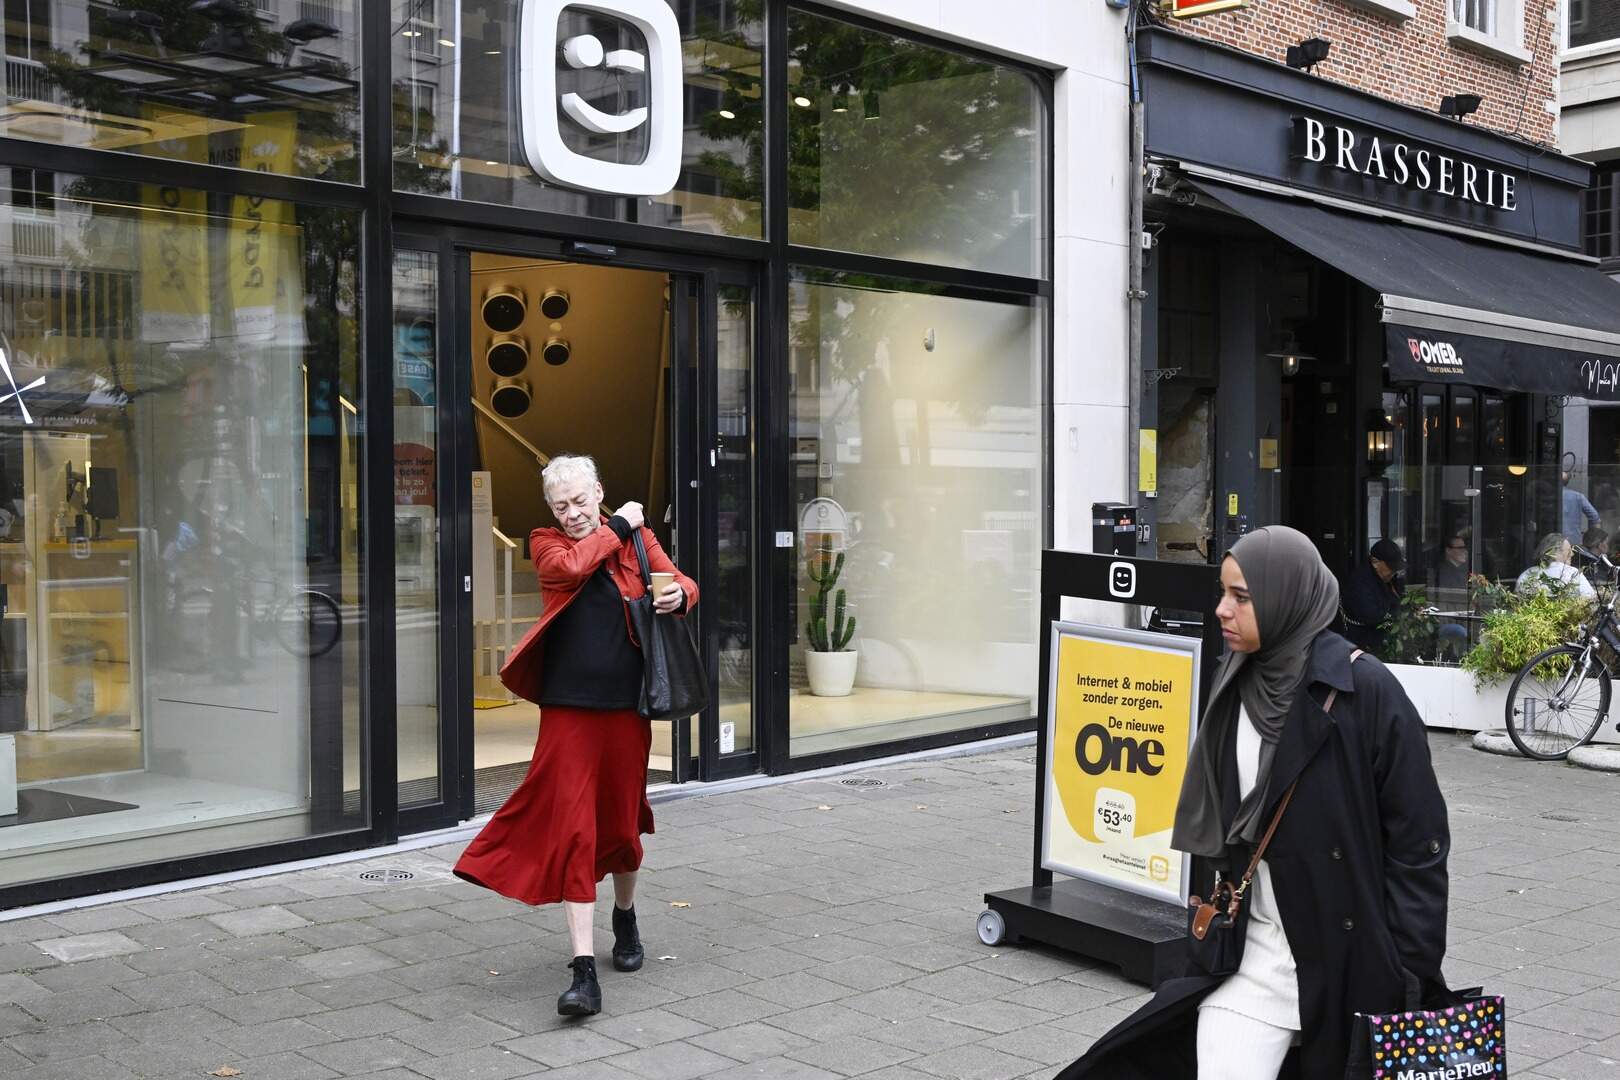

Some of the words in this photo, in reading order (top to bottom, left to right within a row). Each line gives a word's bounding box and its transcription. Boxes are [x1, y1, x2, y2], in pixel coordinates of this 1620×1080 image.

[1304, 117, 1517, 211] BRASSERIE
[1077, 673, 1118, 689] Internet
[1122, 677, 1131, 690] &
[1135, 679, 1172, 693] mobiel
[1083, 692, 1118, 706] zonder
[1121, 694, 1163, 711] zorgen.
[1108, 716, 1122, 730] De
[1125, 718, 1165, 734] nieuwe
[1075, 723, 1165, 776] One
[1397, 1061, 1494, 1080] MarieFleu
